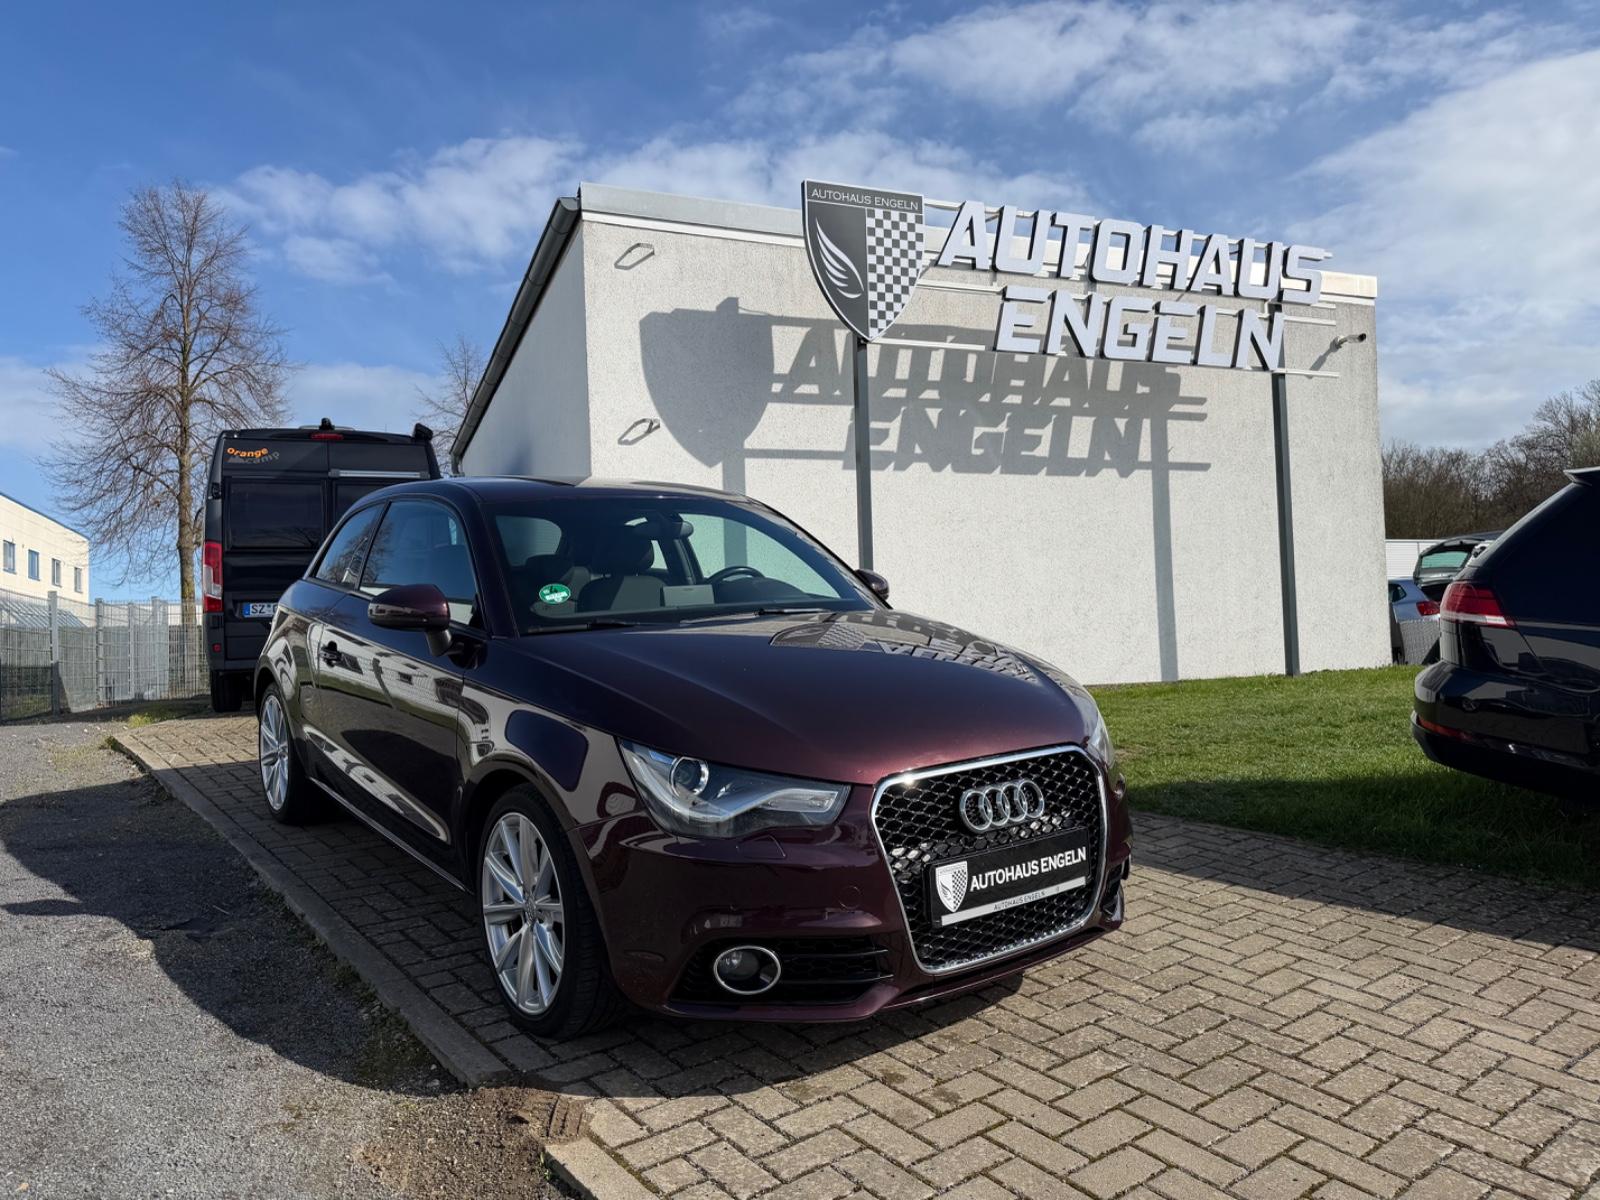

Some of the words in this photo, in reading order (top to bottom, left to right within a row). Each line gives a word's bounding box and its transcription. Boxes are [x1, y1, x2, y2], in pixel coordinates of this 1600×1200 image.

[812, 188, 871, 205] AUTOHAUS
[874, 197, 918, 211] ENGELN
[936, 201, 1328, 305] AUTOHAUS
[996, 286, 1285, 371] ENGELN
[227, 447, 268, 459] orange
[970, 861, 1039, 892] AUTOHAUS
[1040, 846, 1087, 872] ENGELN
